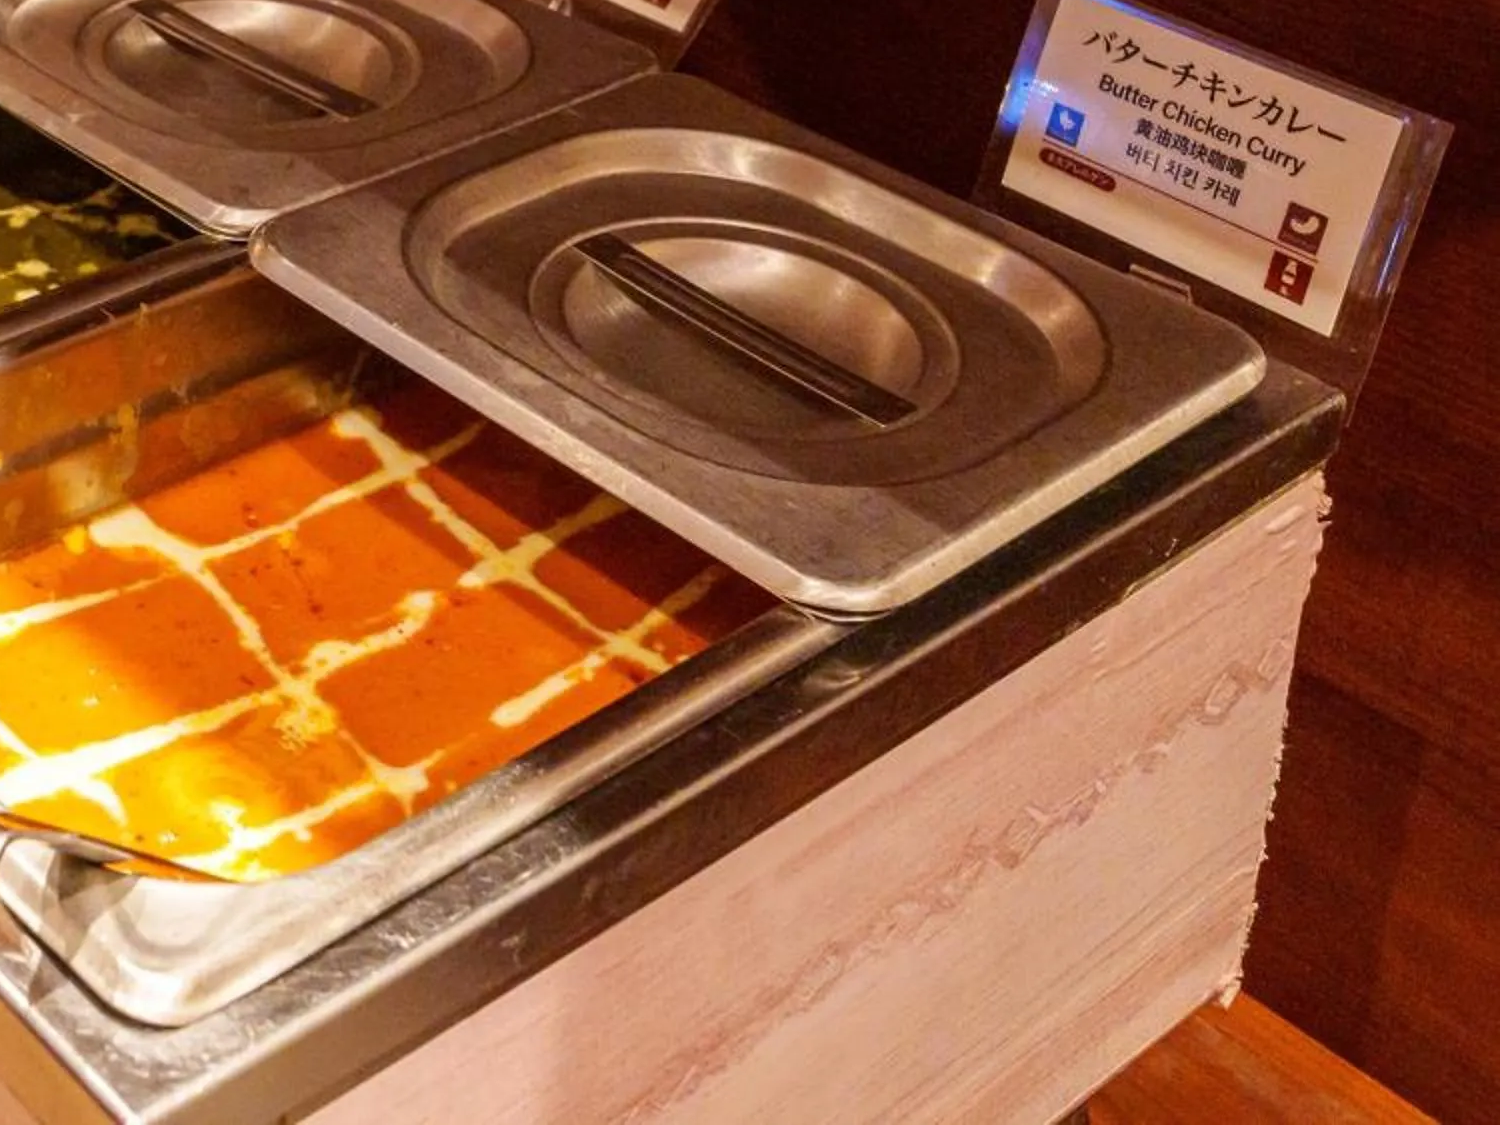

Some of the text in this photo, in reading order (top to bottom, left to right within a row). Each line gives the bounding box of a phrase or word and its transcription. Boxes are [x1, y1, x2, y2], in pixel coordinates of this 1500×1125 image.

[1082, 29, 1347, 144] バターチキンカレー
[1098, 73, 1307, 177] Butter Chicken Curry
[1163, 158, 1201, 190] 치킨
[1202, 177, 1241, 208] 카레
